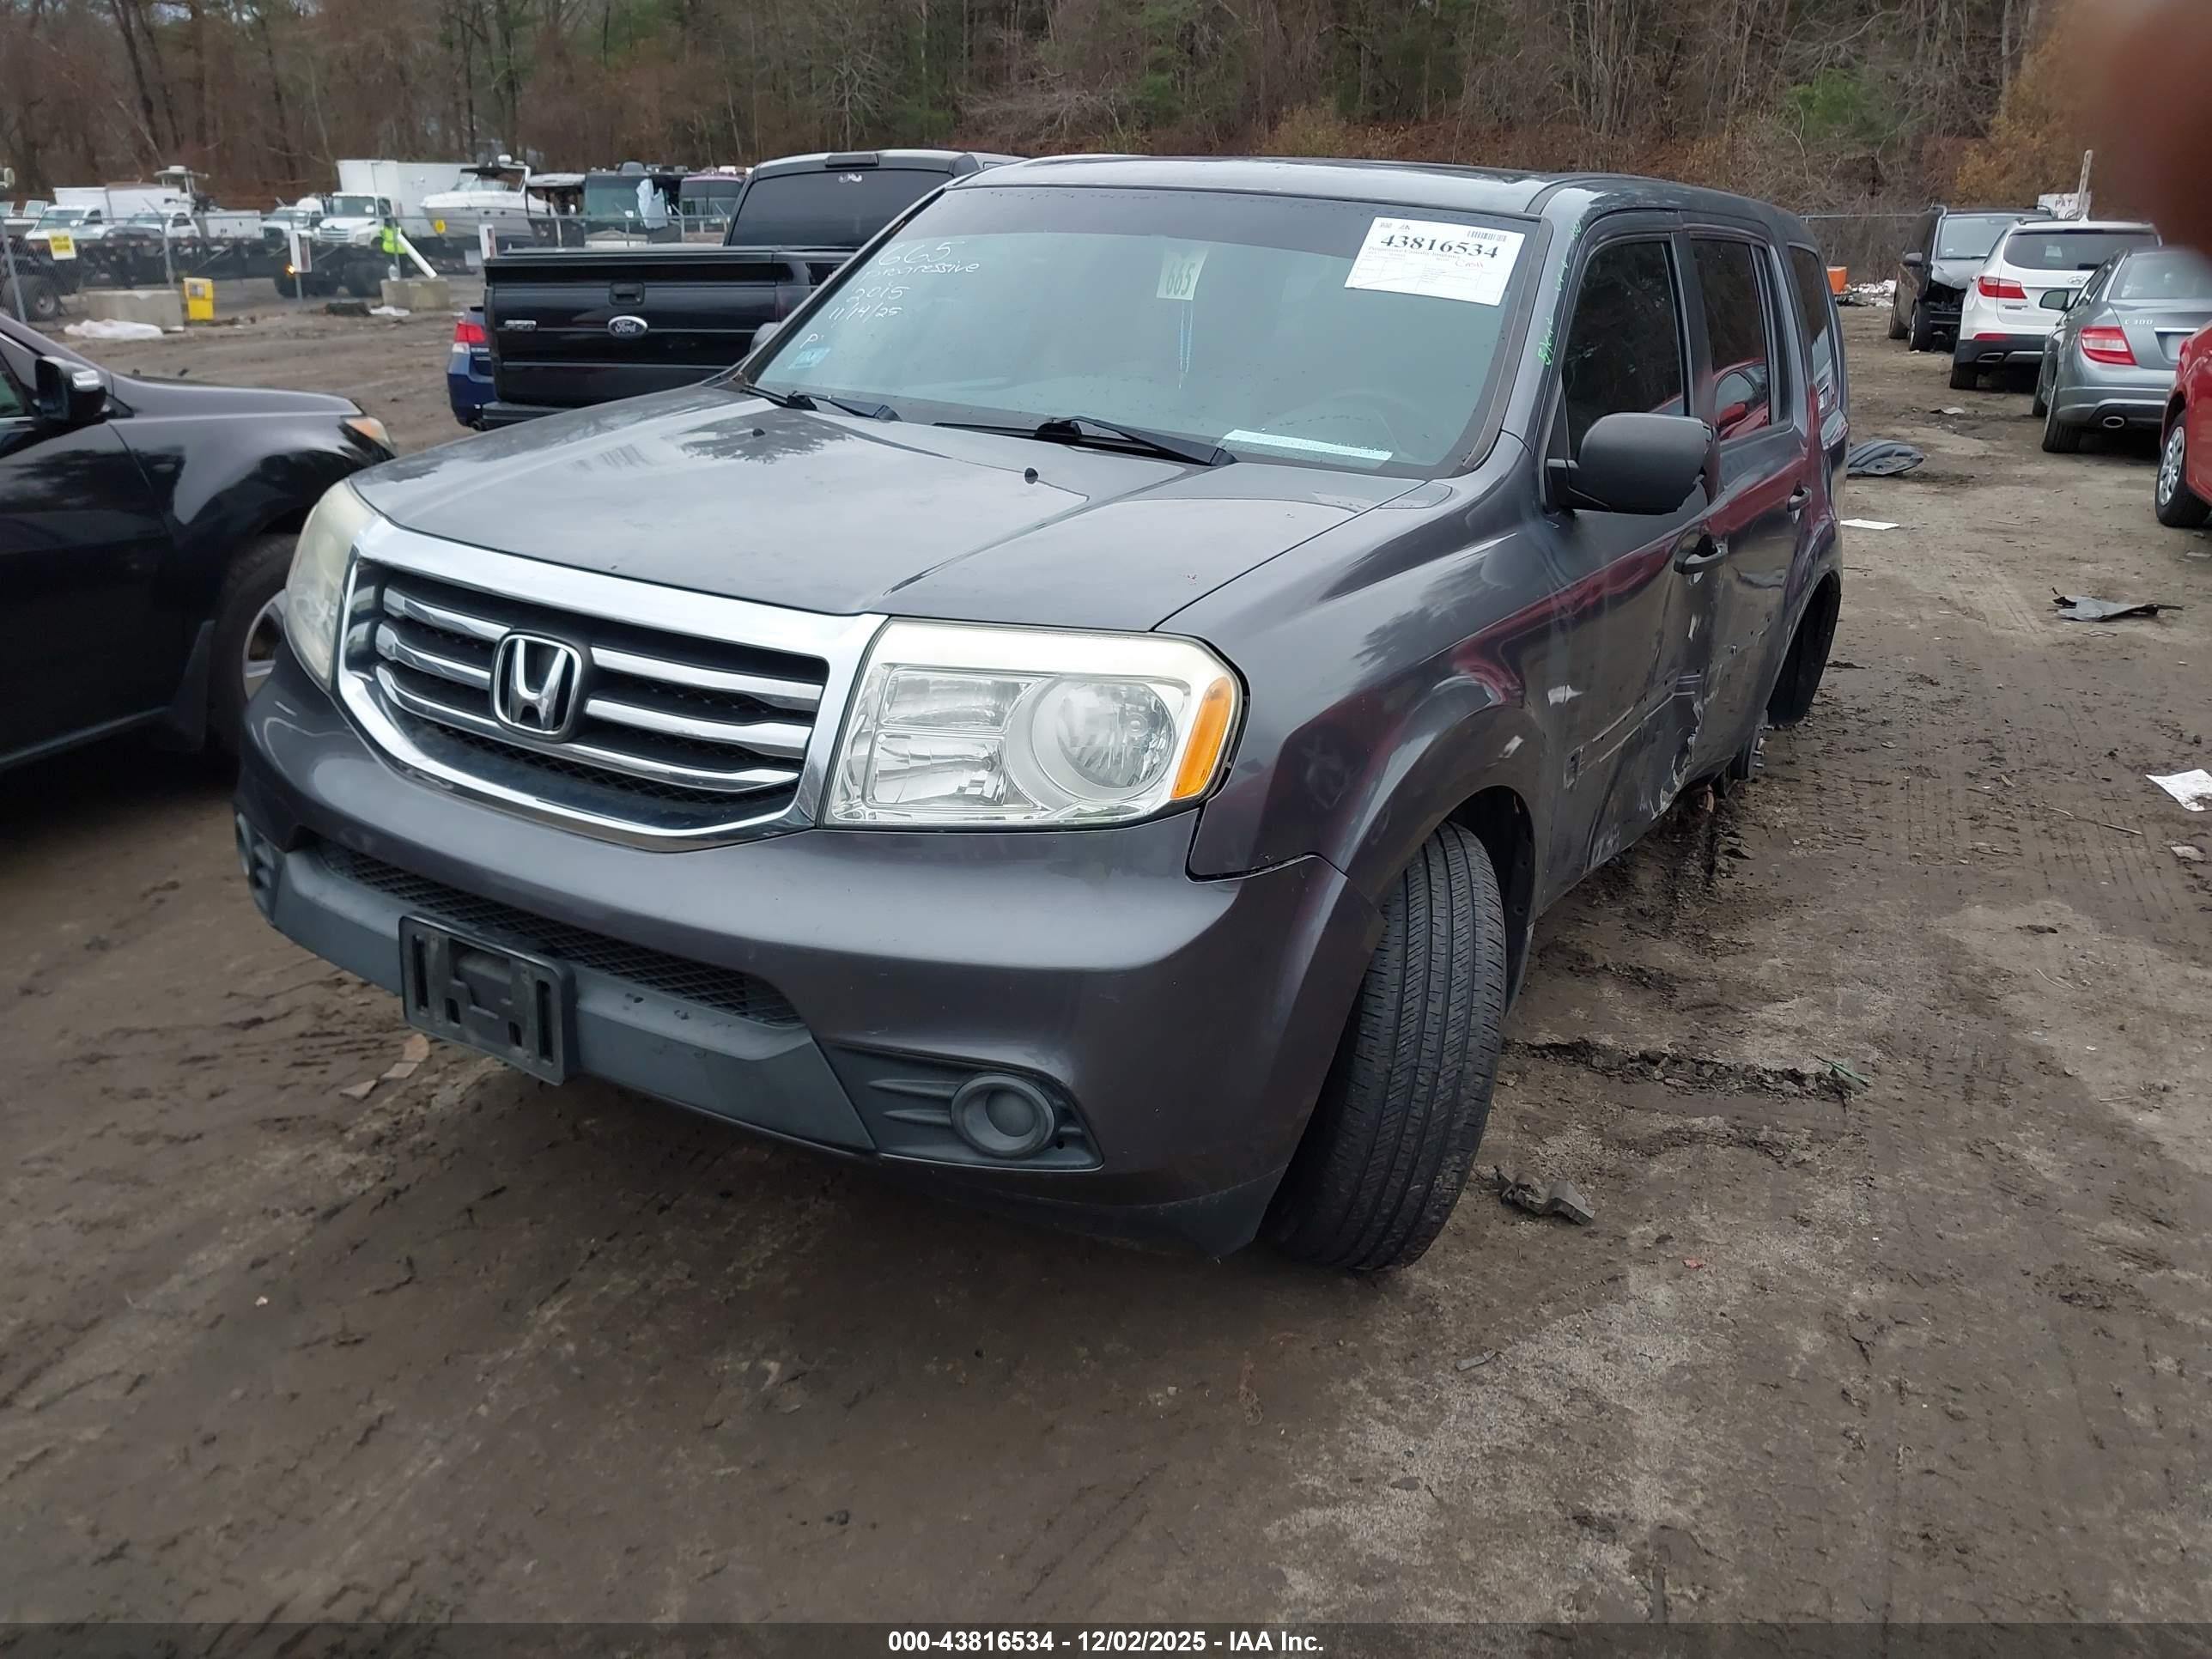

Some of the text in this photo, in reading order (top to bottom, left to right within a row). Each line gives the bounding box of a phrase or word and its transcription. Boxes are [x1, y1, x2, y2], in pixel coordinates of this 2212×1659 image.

[2055, 198, 2073, 207] PAY
[878, 240, 965, 266] 665
[1380, 234, 1498, 258] 43816534
[615, 320, 636, 333] Ford
